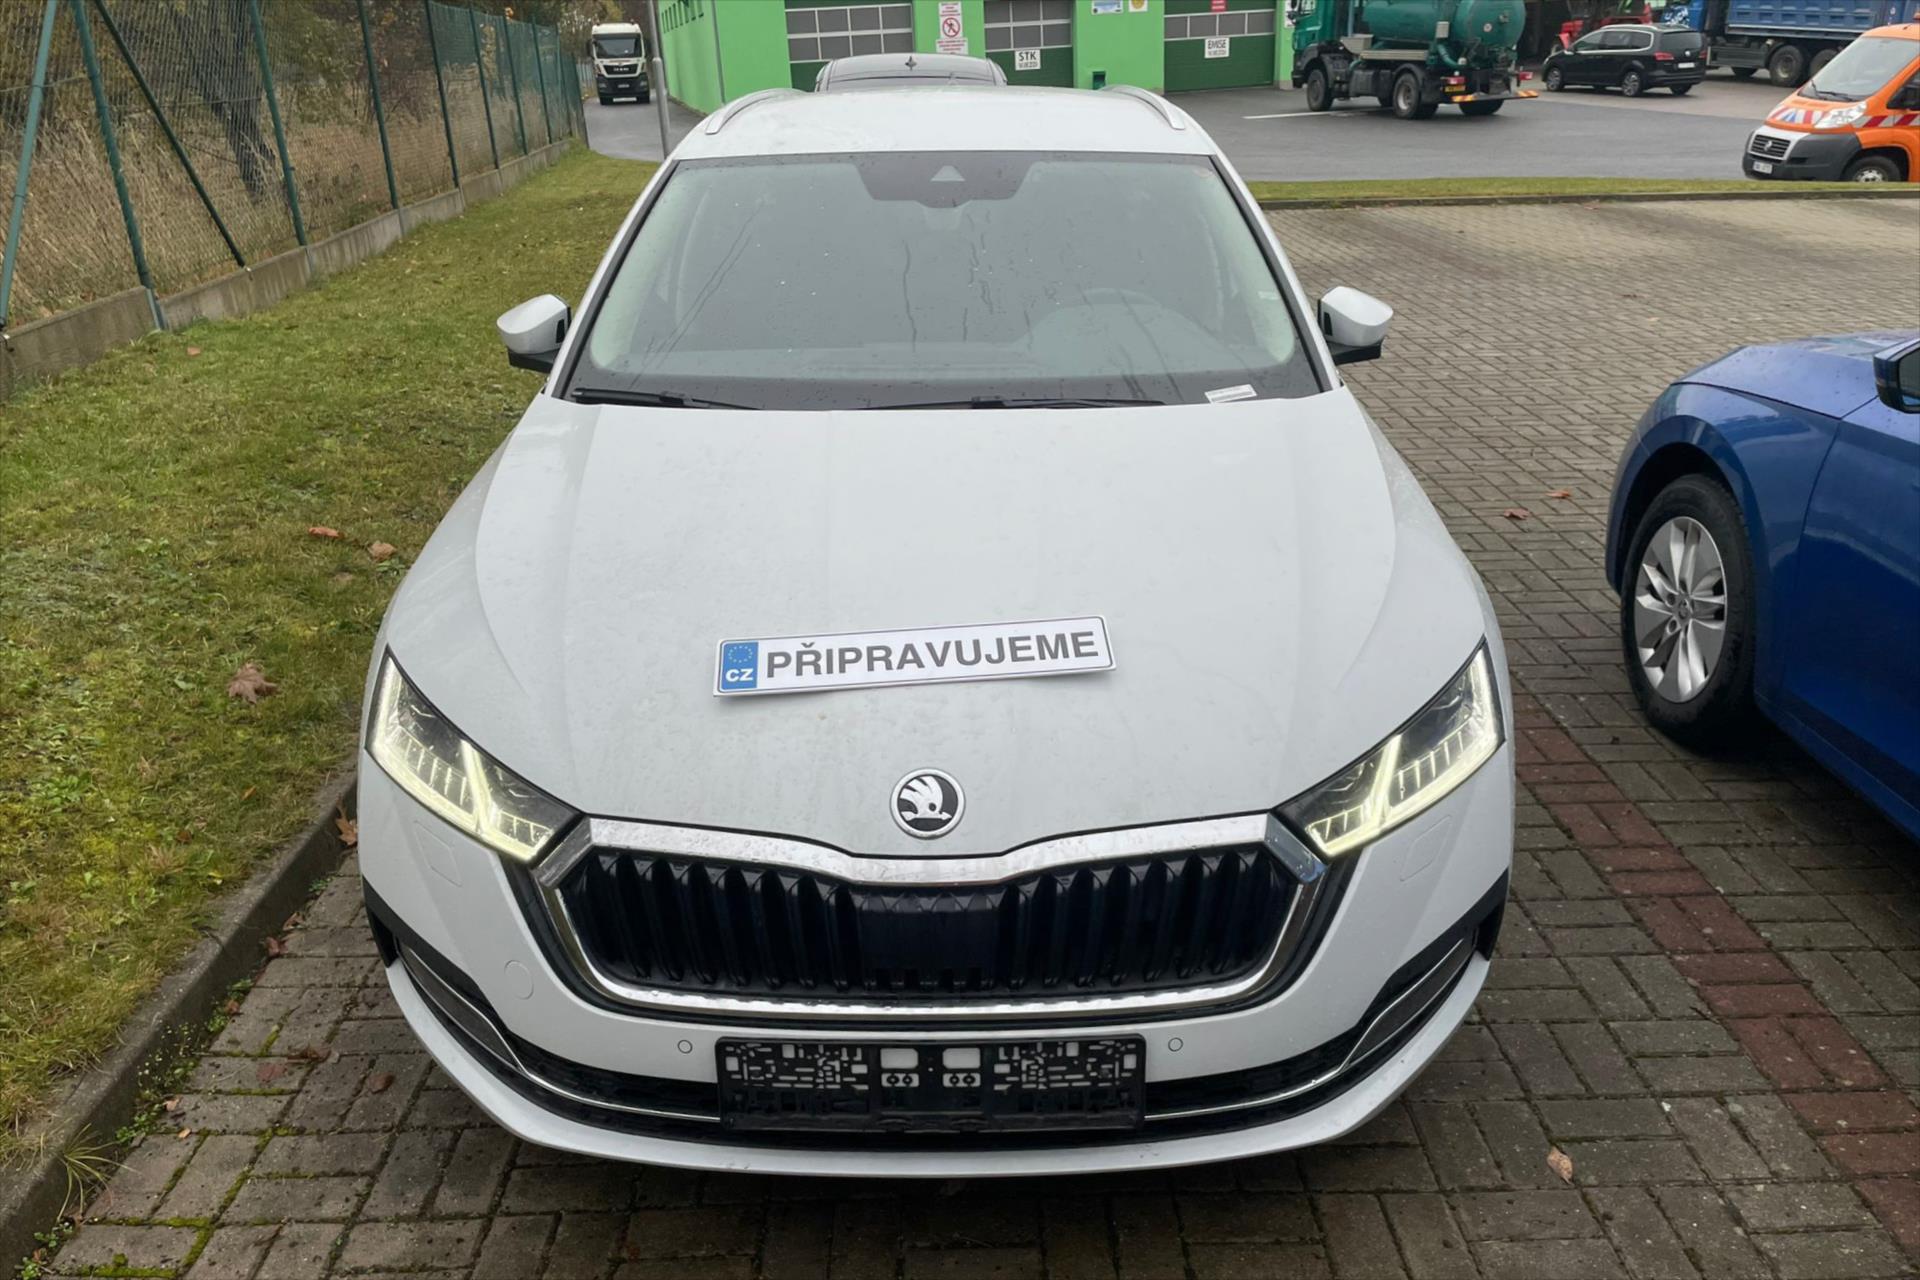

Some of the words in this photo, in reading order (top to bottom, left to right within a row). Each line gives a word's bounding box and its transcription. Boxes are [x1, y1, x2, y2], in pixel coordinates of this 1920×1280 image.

[1018, 51, 1037, 61] STK
[725, 668, 754, 682] CZ
[766, 631, 1099, 678] PŘIPRAVUJEME
